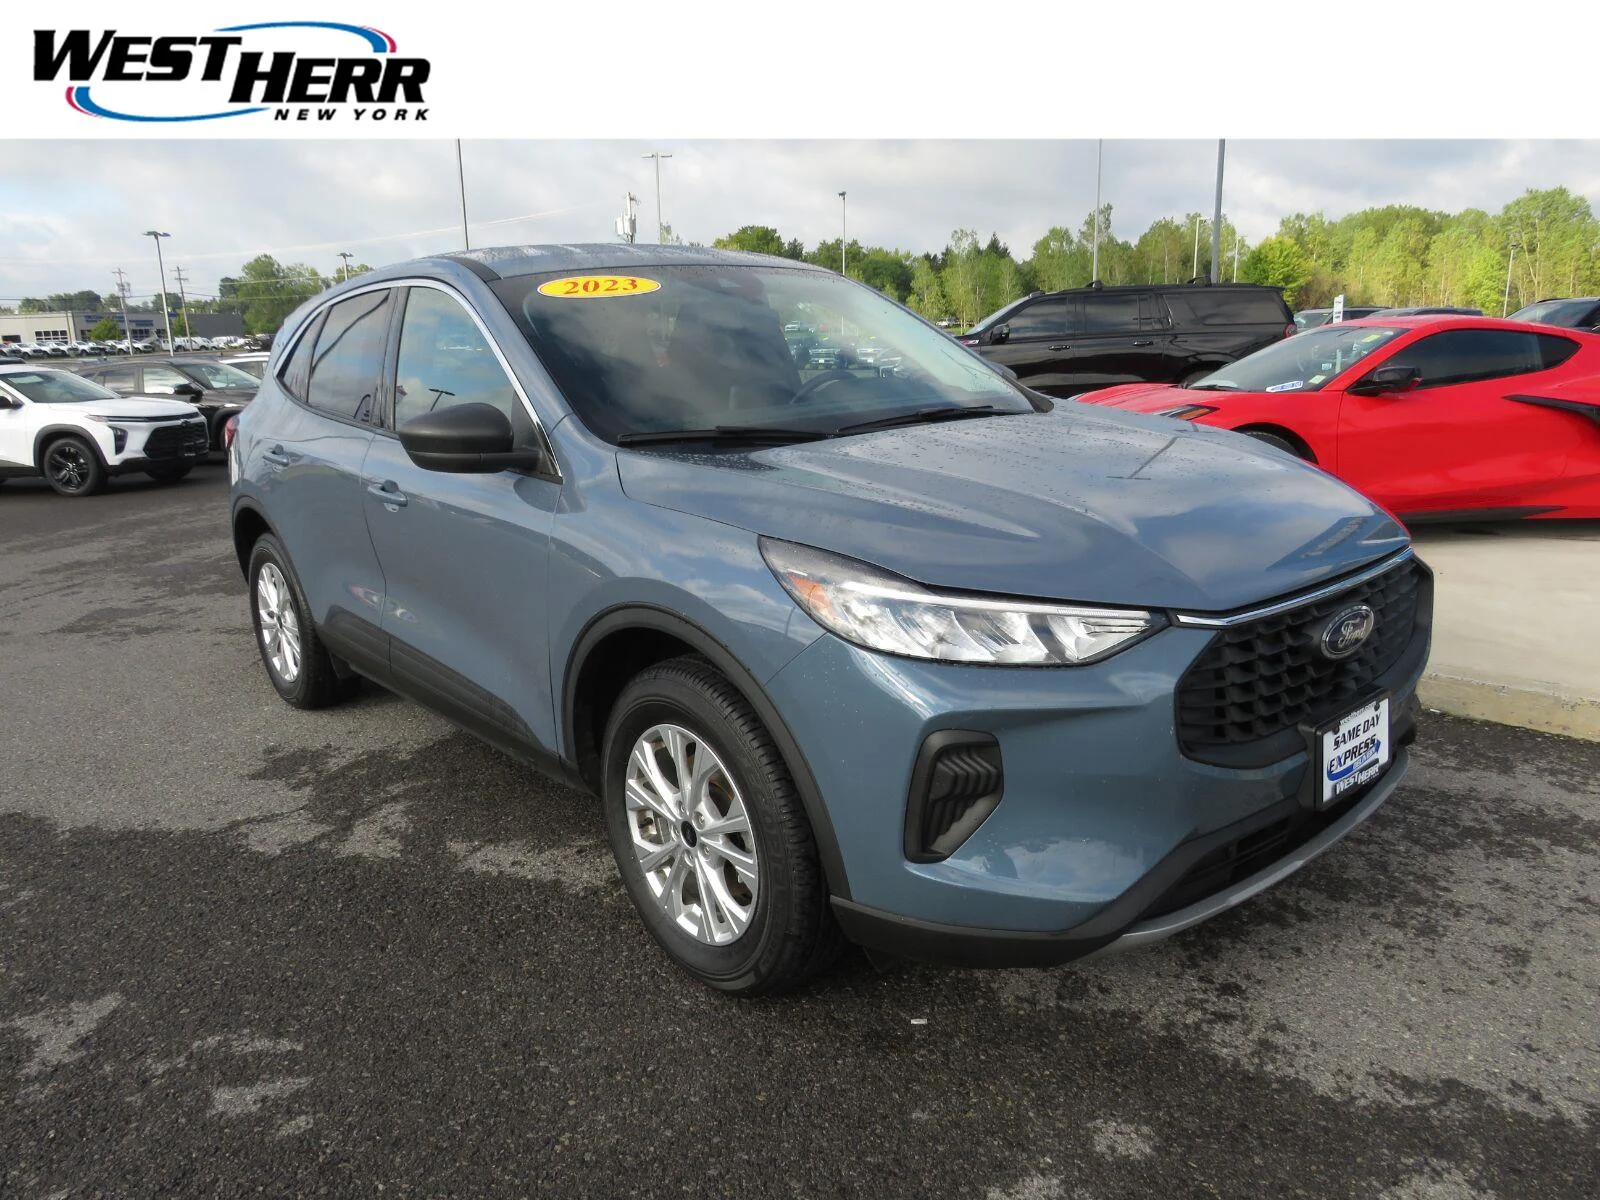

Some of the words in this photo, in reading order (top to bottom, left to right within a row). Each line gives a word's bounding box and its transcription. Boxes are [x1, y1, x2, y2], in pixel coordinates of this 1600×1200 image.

[564, 279, 638, 295] 2023
[1337, 617, 1367, 648] Ford
[1333, 724, 1362, 751] SAME
[1363, 712, 1382, 734] DAY
[1329, 734, 1377, 773] EXPRESS
[1335, 771, 1359, 795] WEST
[1357, 765, 1379, 785] HERR
